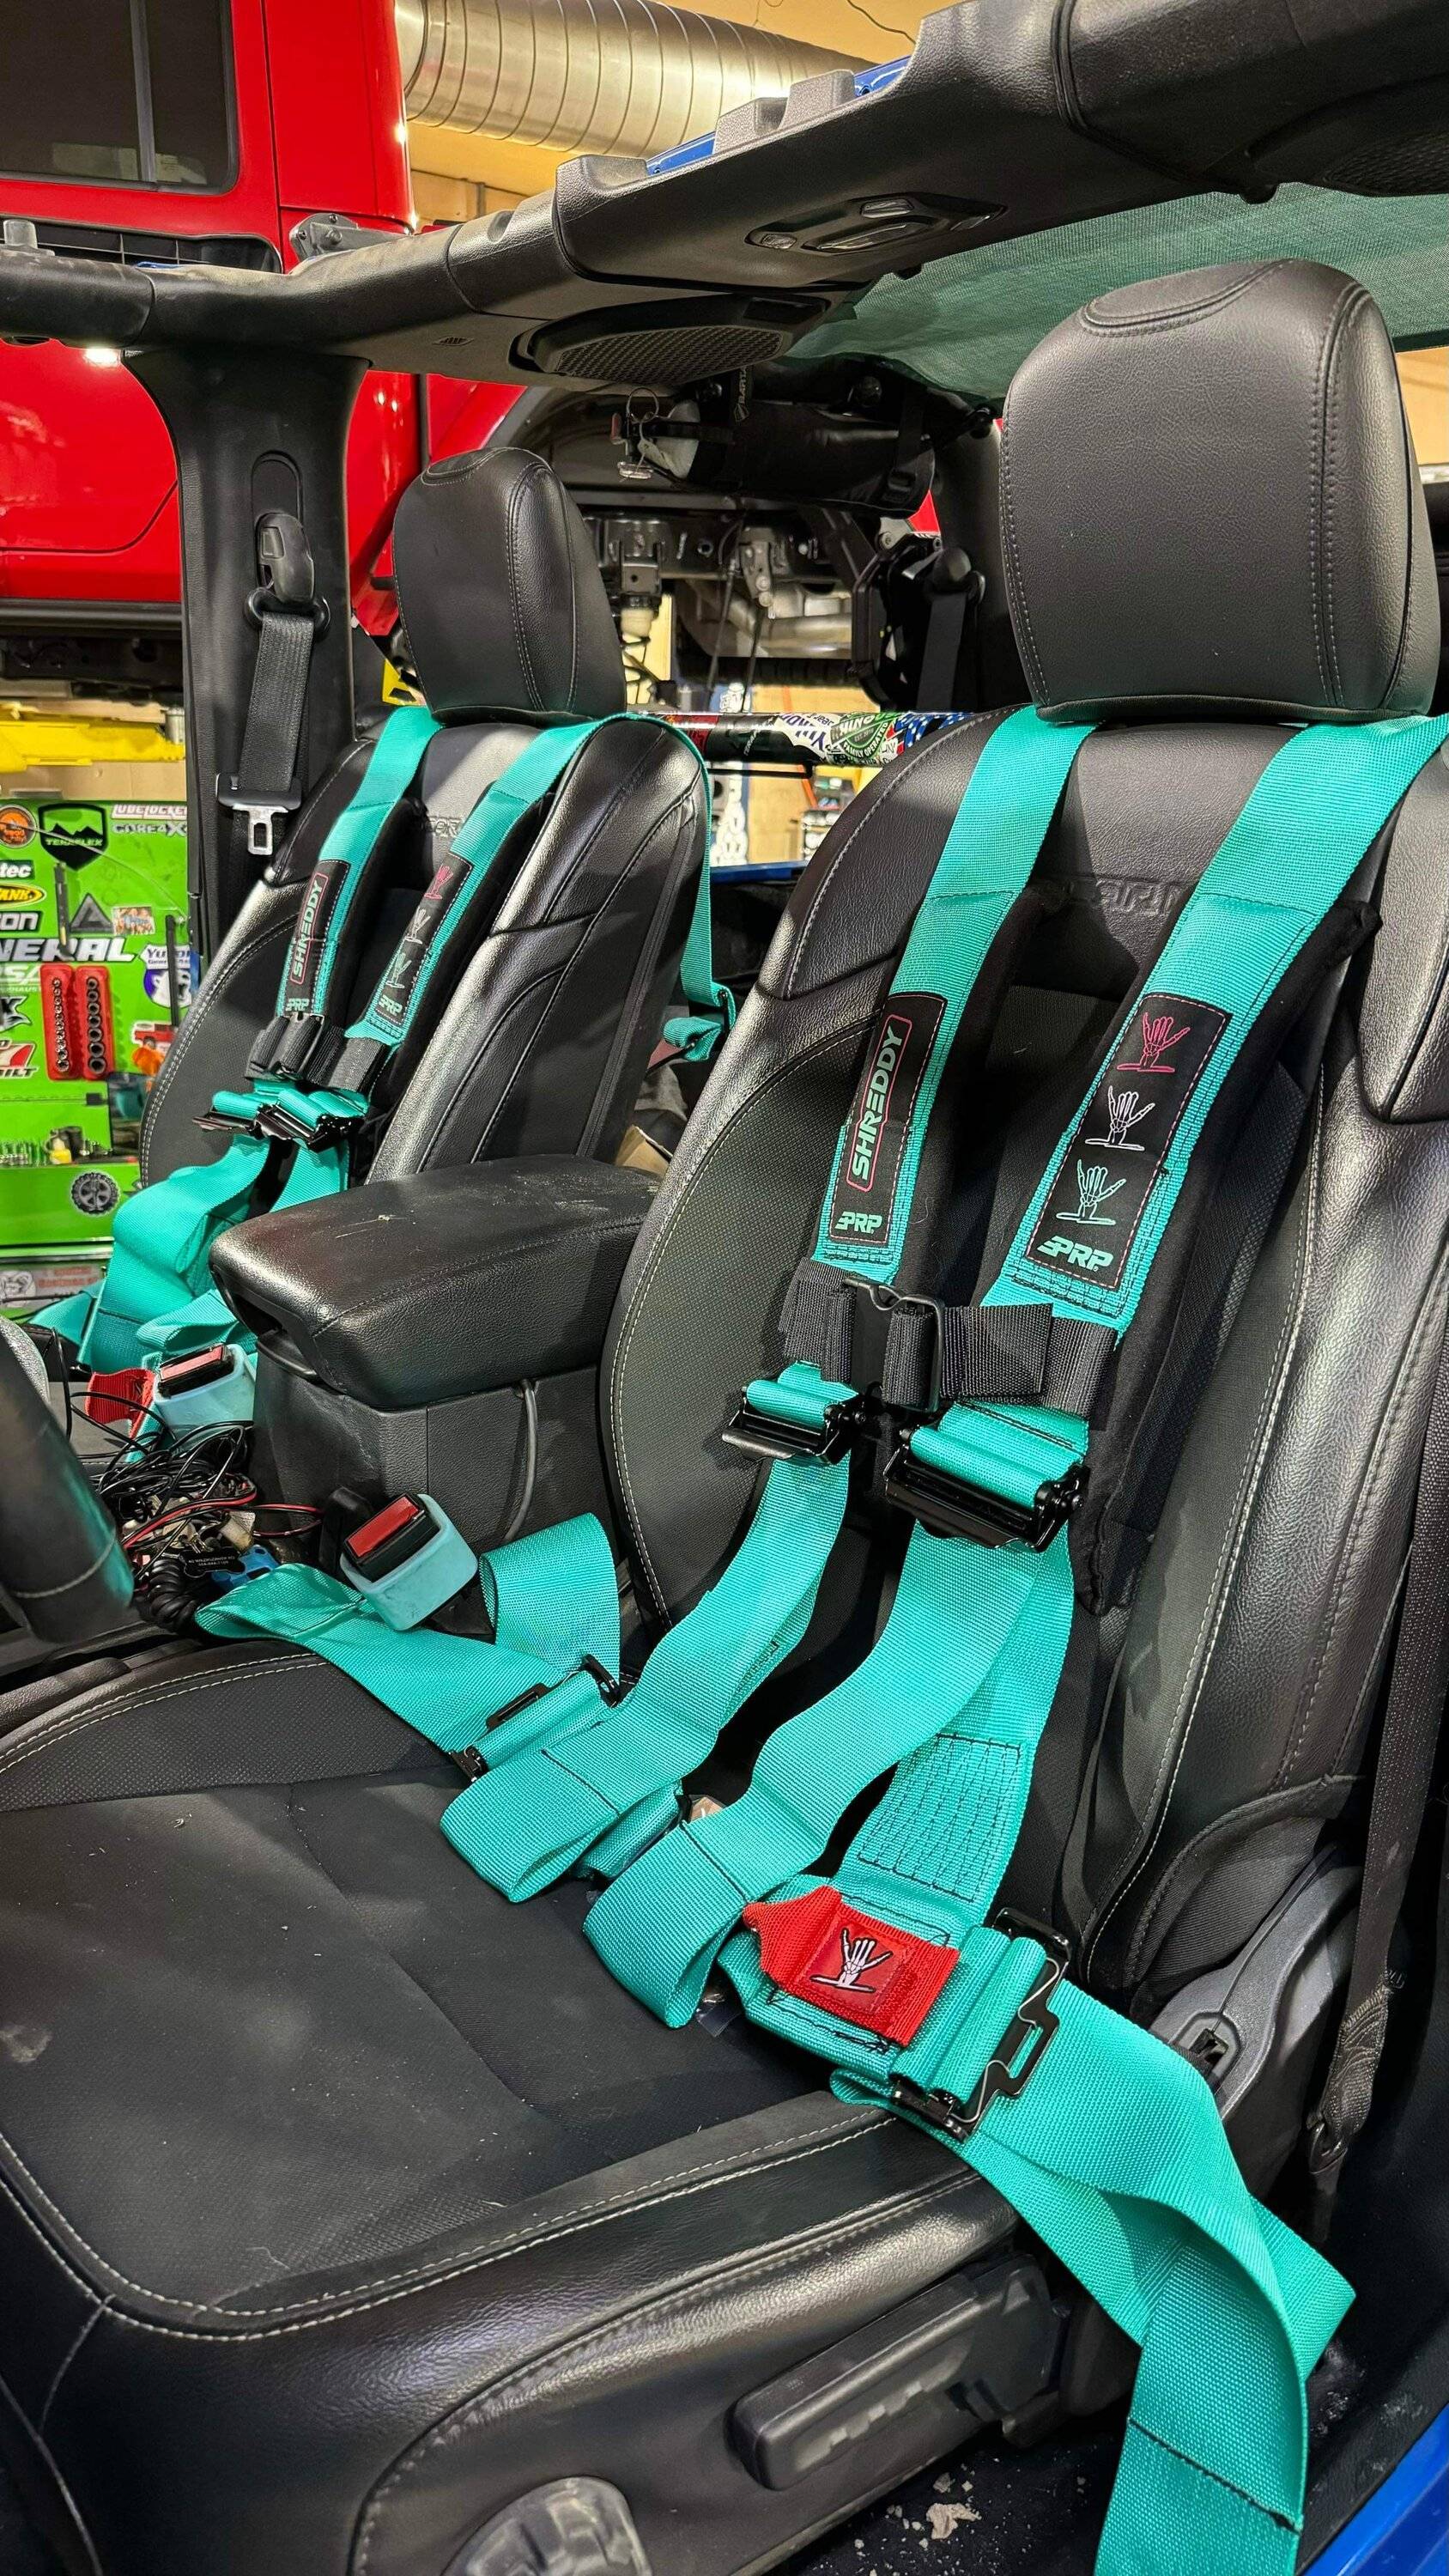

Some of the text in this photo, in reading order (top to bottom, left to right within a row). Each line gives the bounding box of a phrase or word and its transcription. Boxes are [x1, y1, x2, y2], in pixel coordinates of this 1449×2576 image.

[864, 722, 888, 756] OPERATED
[293, 880, 322, 977] SHREDDY
[379, 994, 403, 1016] PRP
[852, 1025, 902, 1180] SHREDDY
[834, 1211, 882, 1234] PRP
[1037, 1236, 1113, 1272] PRP
